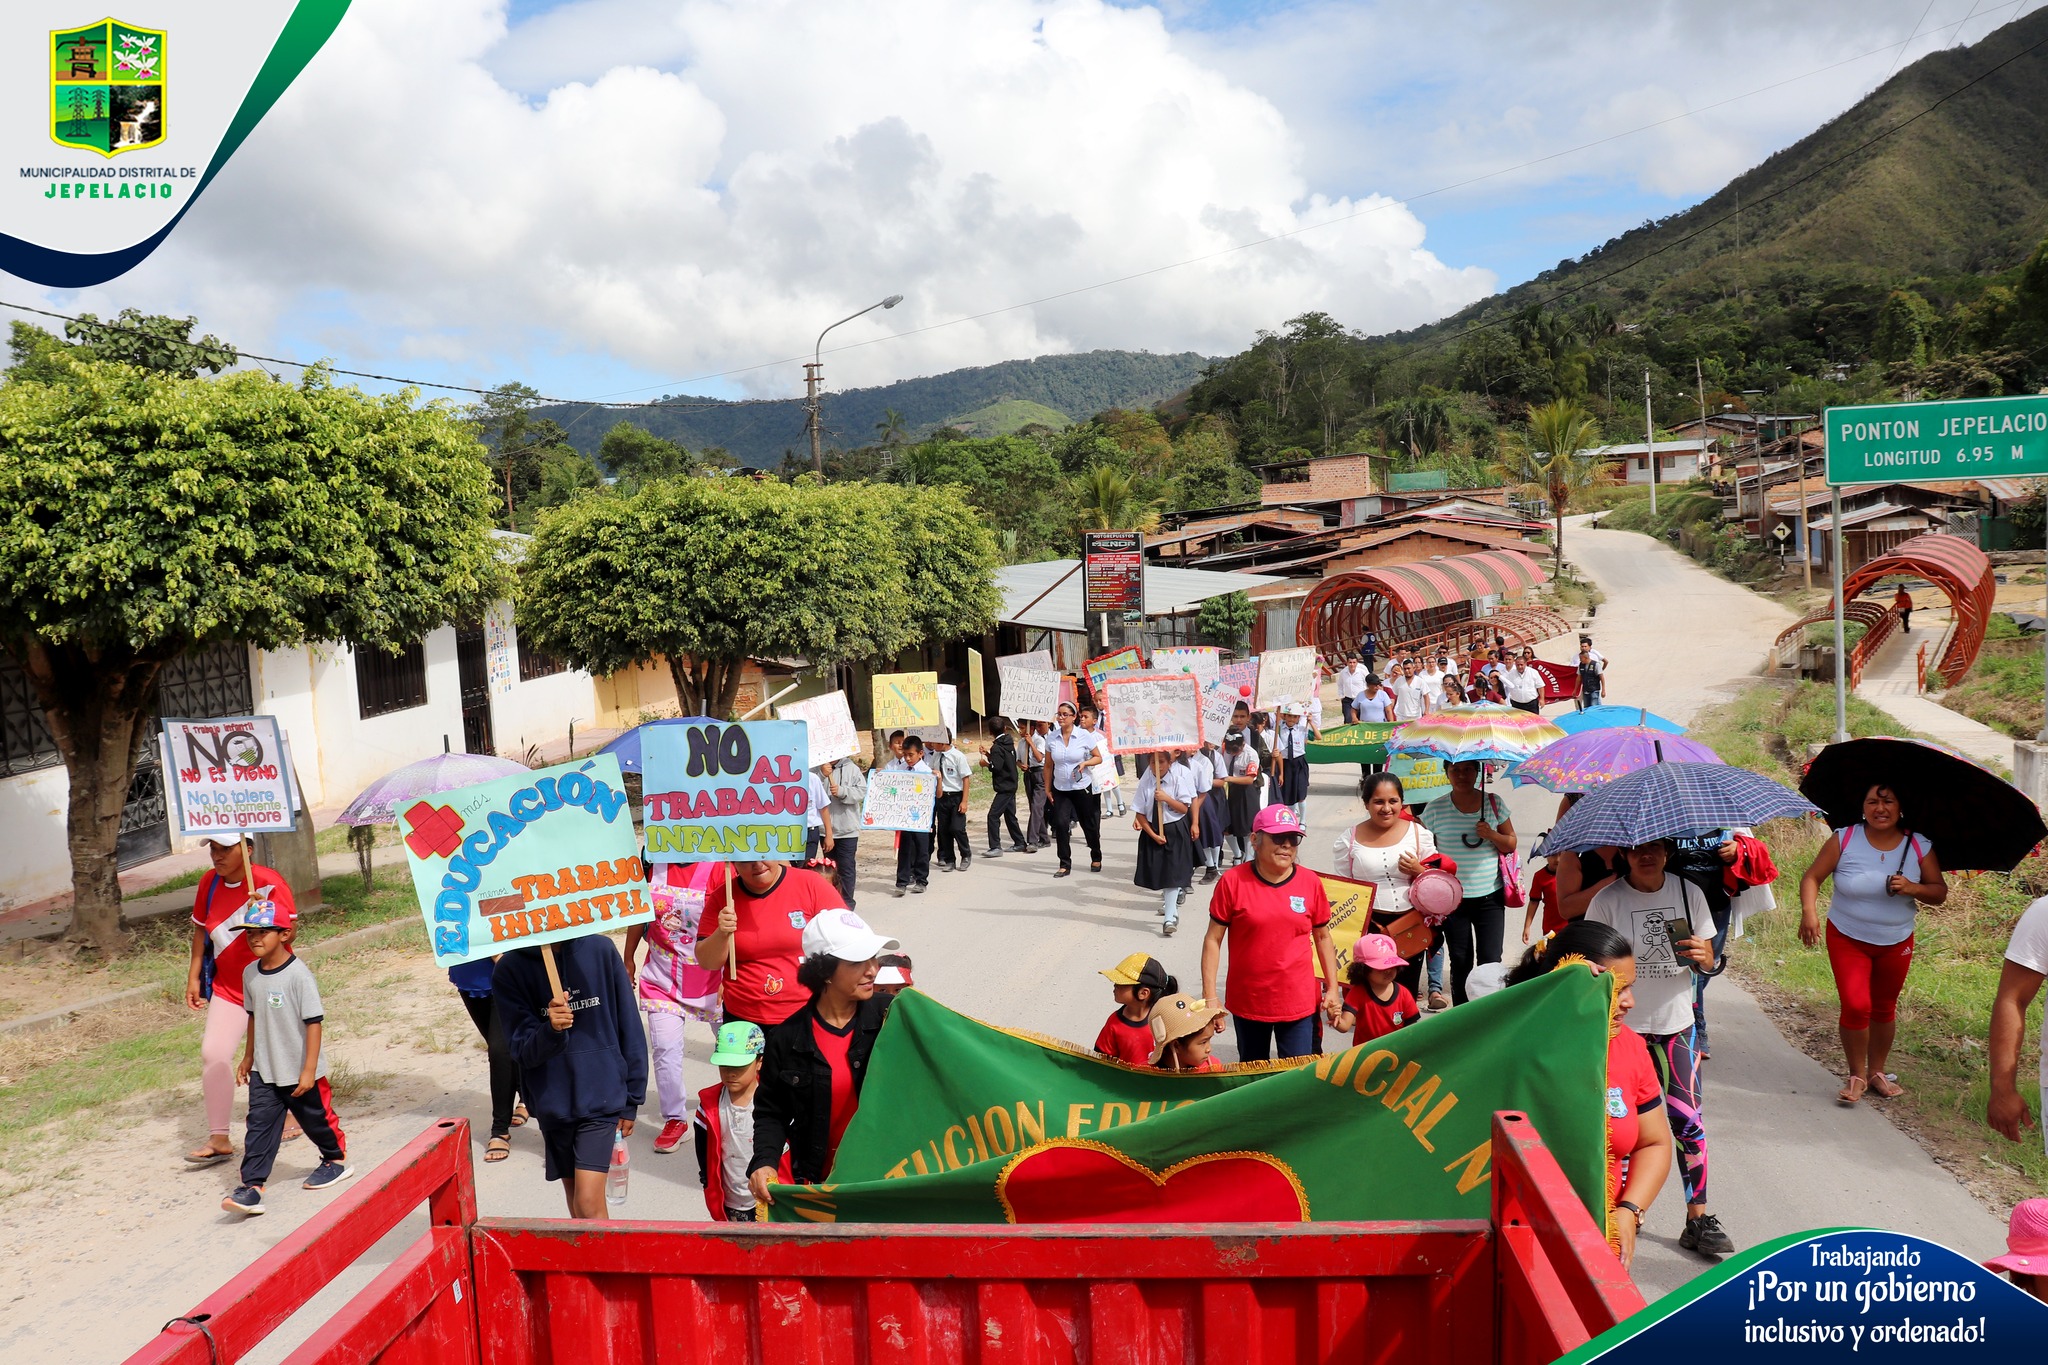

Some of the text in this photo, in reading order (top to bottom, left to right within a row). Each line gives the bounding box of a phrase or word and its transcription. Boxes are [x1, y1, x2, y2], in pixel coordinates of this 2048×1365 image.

[1841, 412, 2047, 442] PONTON JEPELACIO
[1864, 445, 2024, 467] LONGITUD 6.95 M
[907, 674, 920, 684] NO
[1202, 685, 1212, 695] SE
[1216, 703, 1231, 715] SEA
[1364, 731, 1378, 740] DE
[186, 731, 264, 773] NO
[687, 724, 751, 777] NO
[180, 765, 278, 783] NO ES DIGNO
[749, 755, 802, 784] AL
[1410, 760, 1437, 775] SEA
[187, 789, 275, 805] No lo tolere
[461, 793, 491, 818] más
[644, 786, 808, 820] TRABAJO
[189, 810, 282, 827] No lo ignore
[203, 803, 219, 814] No
[646, 824, 808, 854] INFANTIL
[434, 760, 627, 957] EDUCACIÓN
[512, 855, 645, 902] TRABAJO
[478, 887, 508, 900] menos
[488, 889, 650, 942] INFANTIL
[1329, 893, 1359, 920] AJANDO
[568, 996, 601, 1011] HILFIGER
